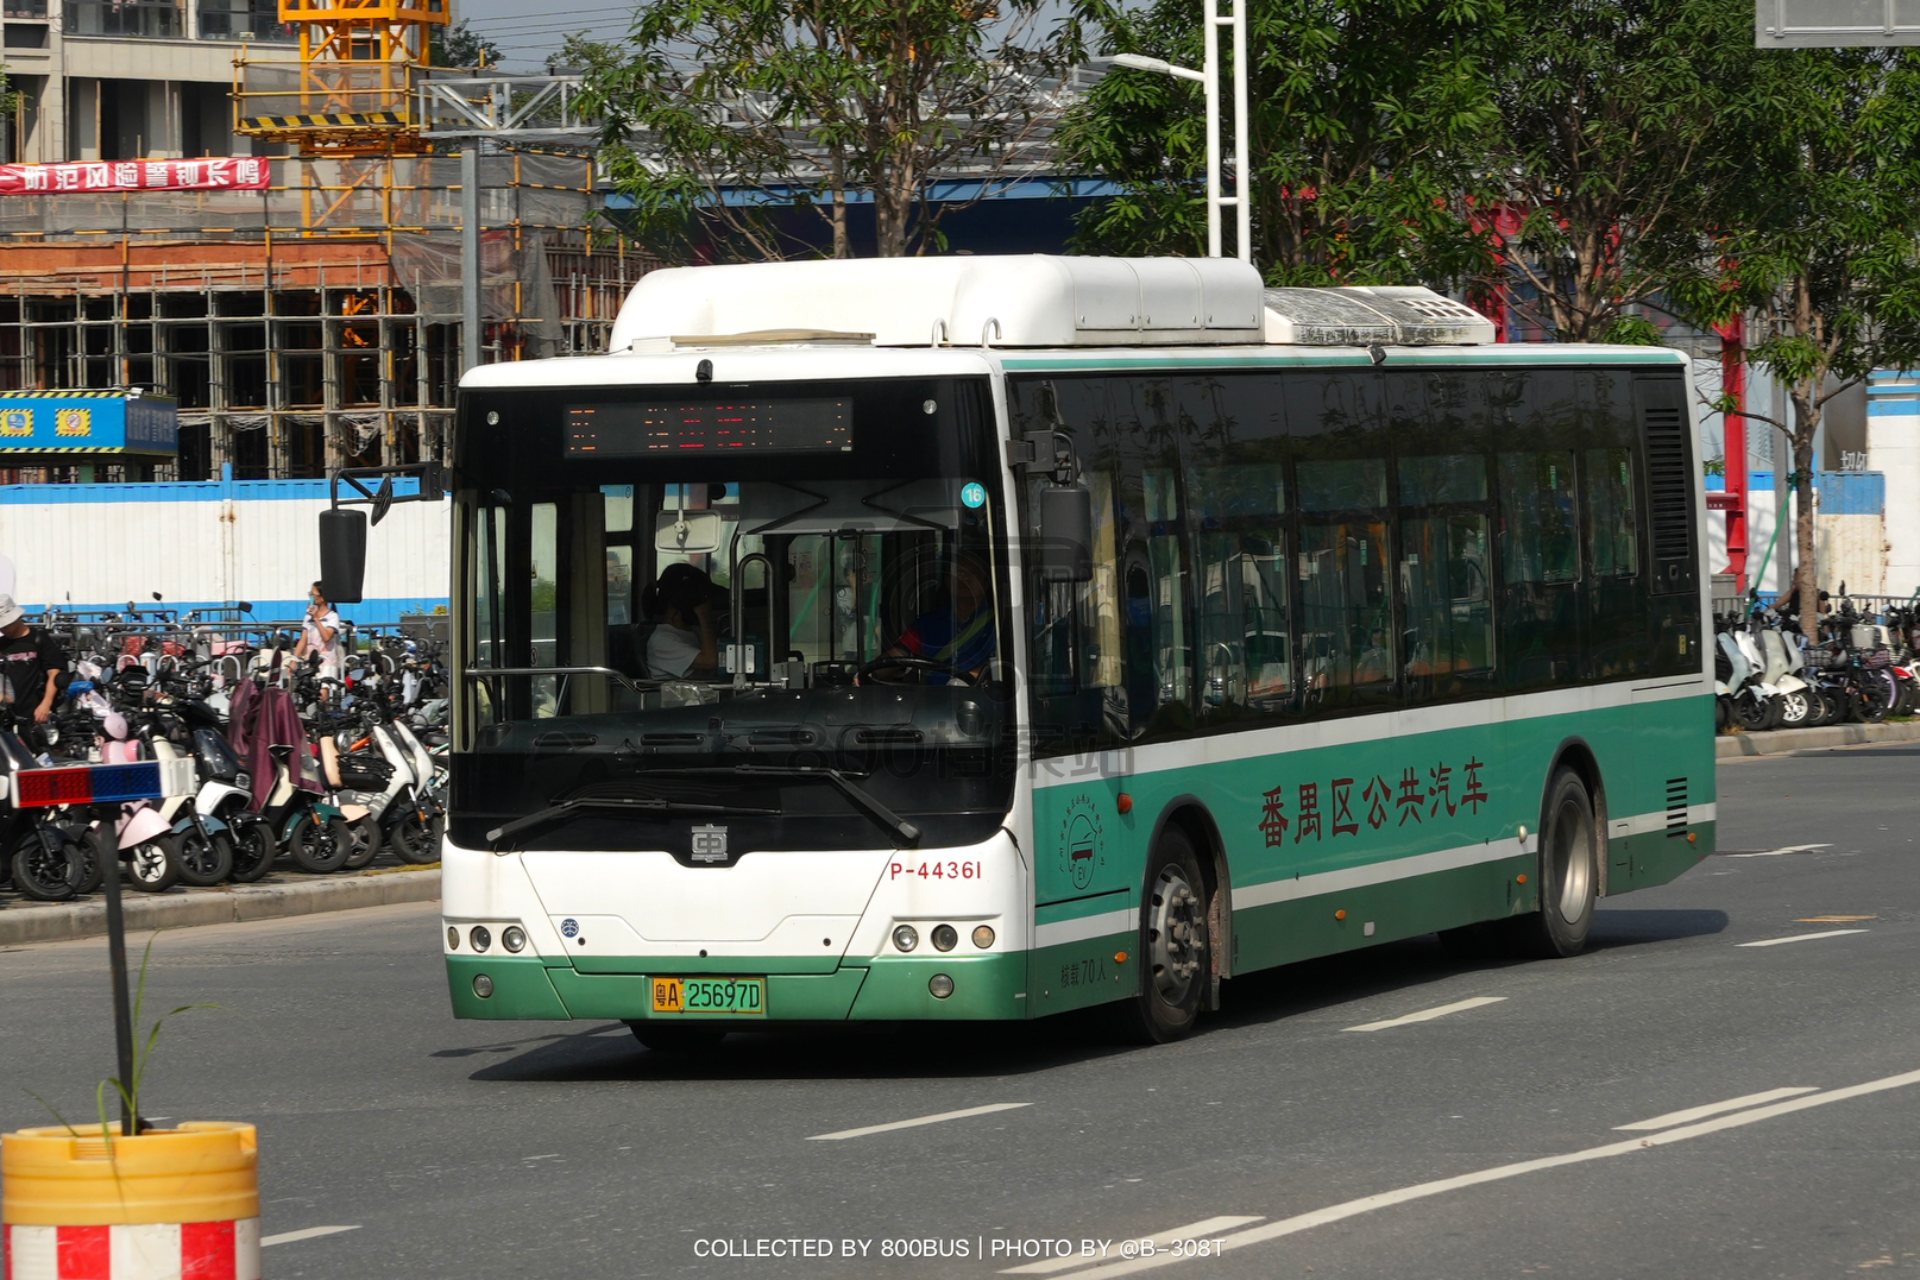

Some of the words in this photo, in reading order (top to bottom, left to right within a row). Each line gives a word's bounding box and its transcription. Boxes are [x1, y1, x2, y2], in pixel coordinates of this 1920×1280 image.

[965, 488, 983, 503] 16
[1258, 755, 1489, 849] 番禺区公共汽车
[890, 861, 981, 881] P-44361
